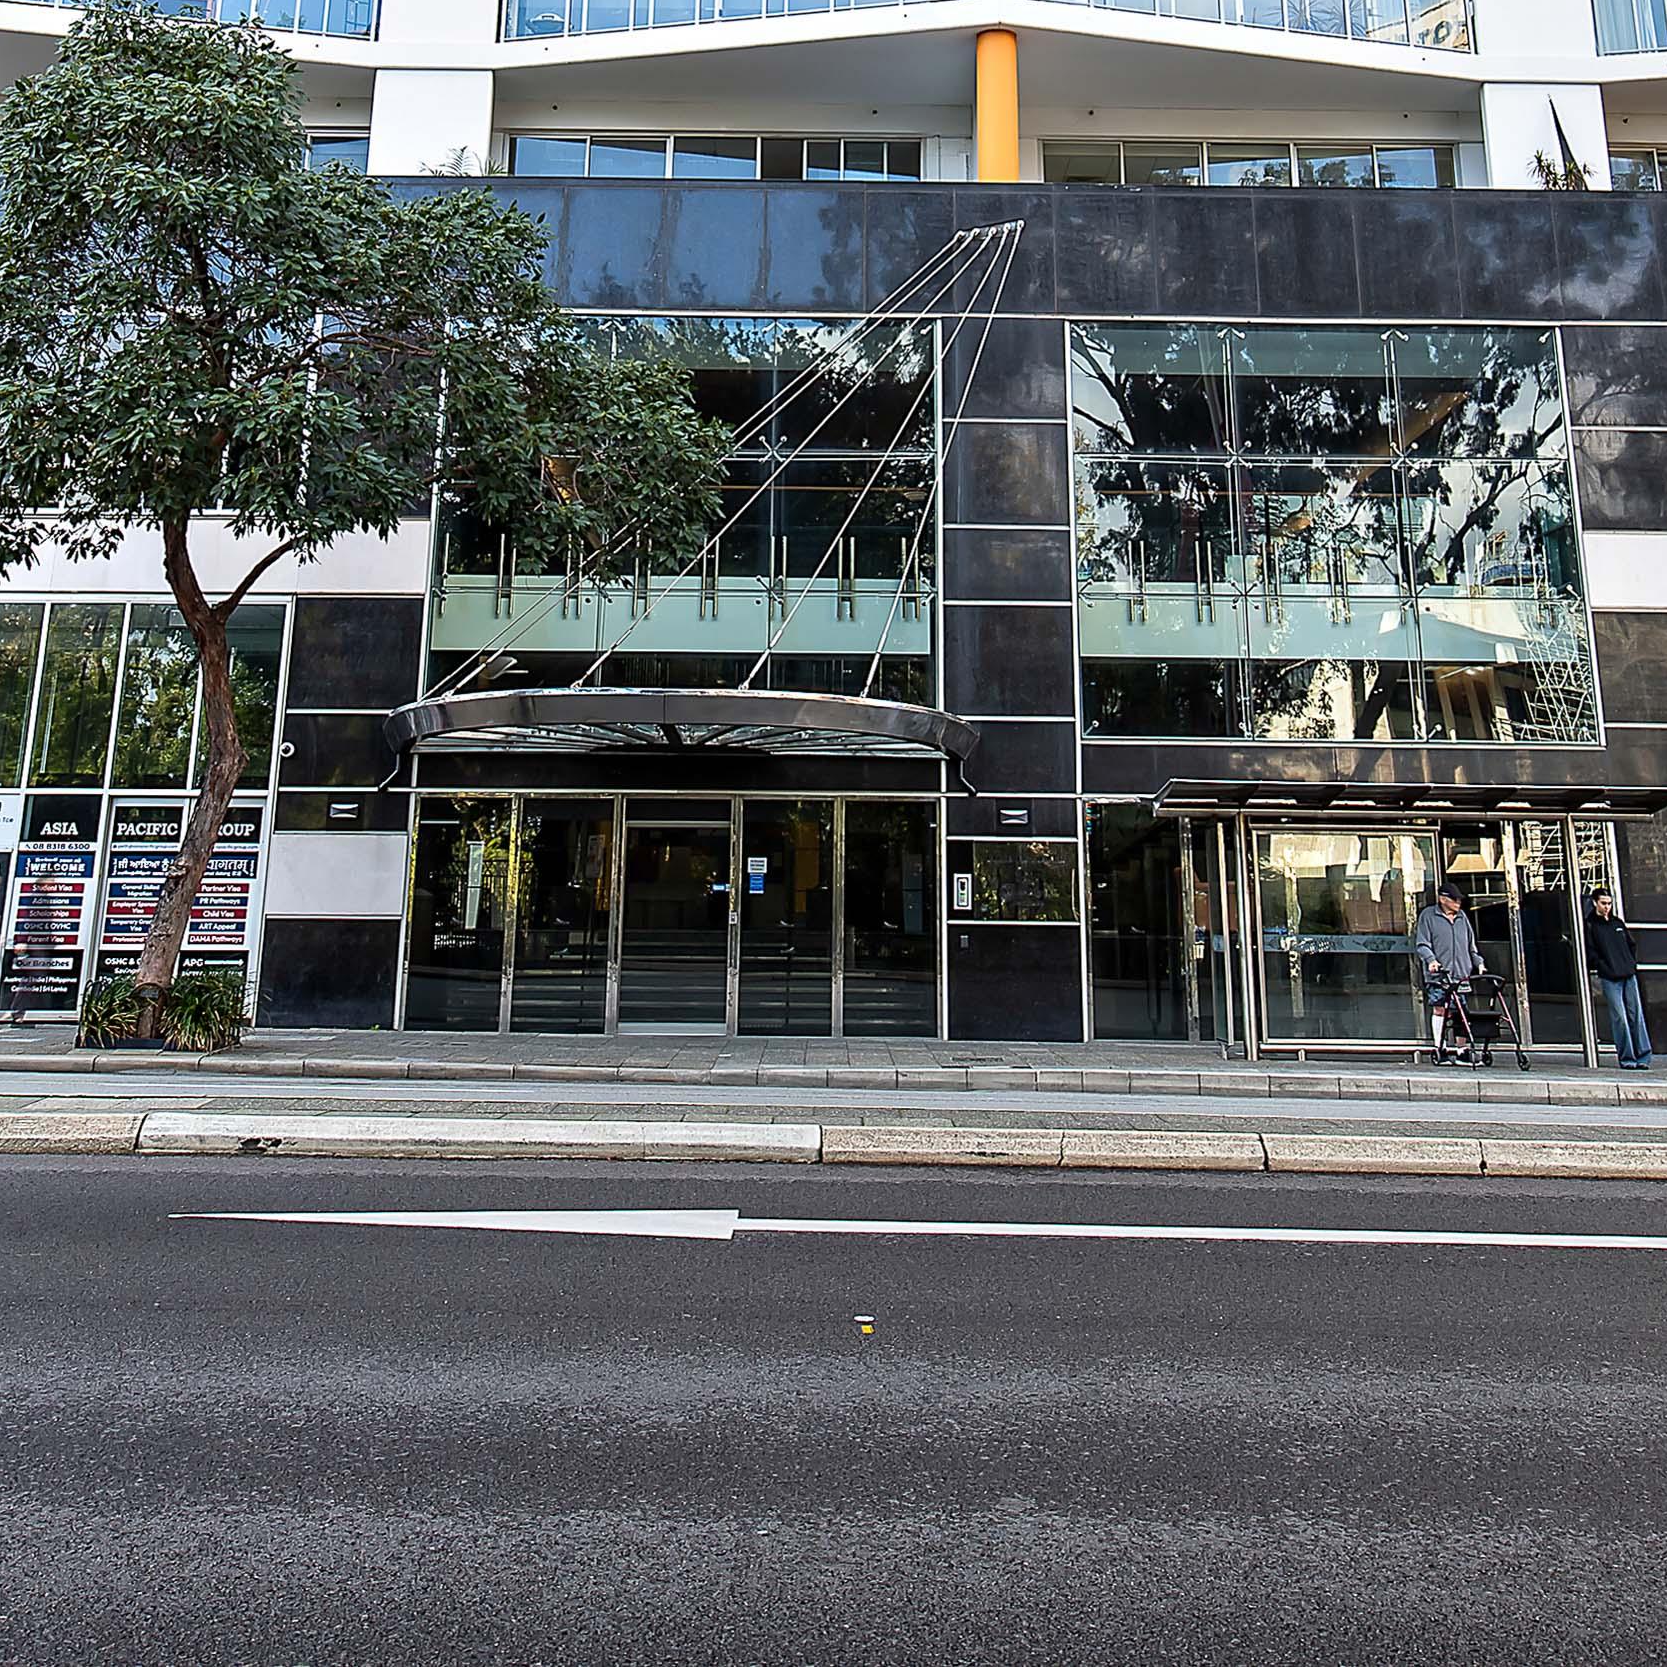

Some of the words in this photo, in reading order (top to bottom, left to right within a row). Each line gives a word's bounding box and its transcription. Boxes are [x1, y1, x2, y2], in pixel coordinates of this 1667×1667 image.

[40, 822, 79, 835] ASIA
[116, 822, 179, 836] PACIFIC
[29, 862, 86, 872] WELCOME
[33, 959, 70, 967] Branches
[182, 958, 204, 967] APG
